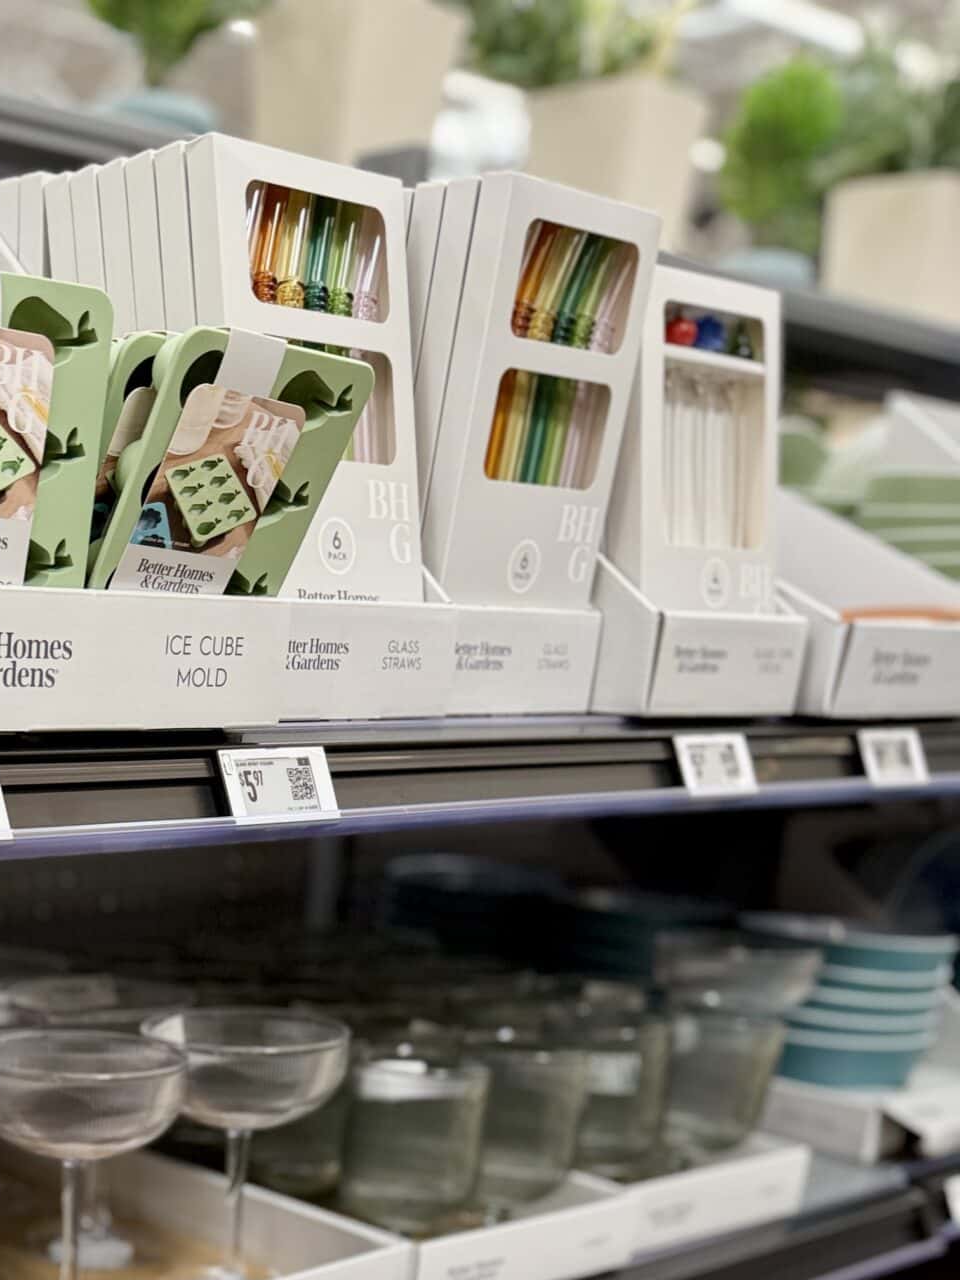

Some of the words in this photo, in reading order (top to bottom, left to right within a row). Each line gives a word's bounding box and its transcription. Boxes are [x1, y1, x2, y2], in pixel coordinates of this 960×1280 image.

[367, 480, 410, 521] BH
[332, 530, 342, 551] 6
[389, 522, 412, 564] G
[136, 558, 176, 577] Better
[173, 563, 216, 583] Homes
[165, 634, 192, 656] ICE
[199, 636, 244, 657] CUBE
[309, 637, 350, 655] Homes
[387, 639, 420, 654] GLASS
[381, 656, 422, 671] STRAWS
[176, 667, 228, 688] MOLD
